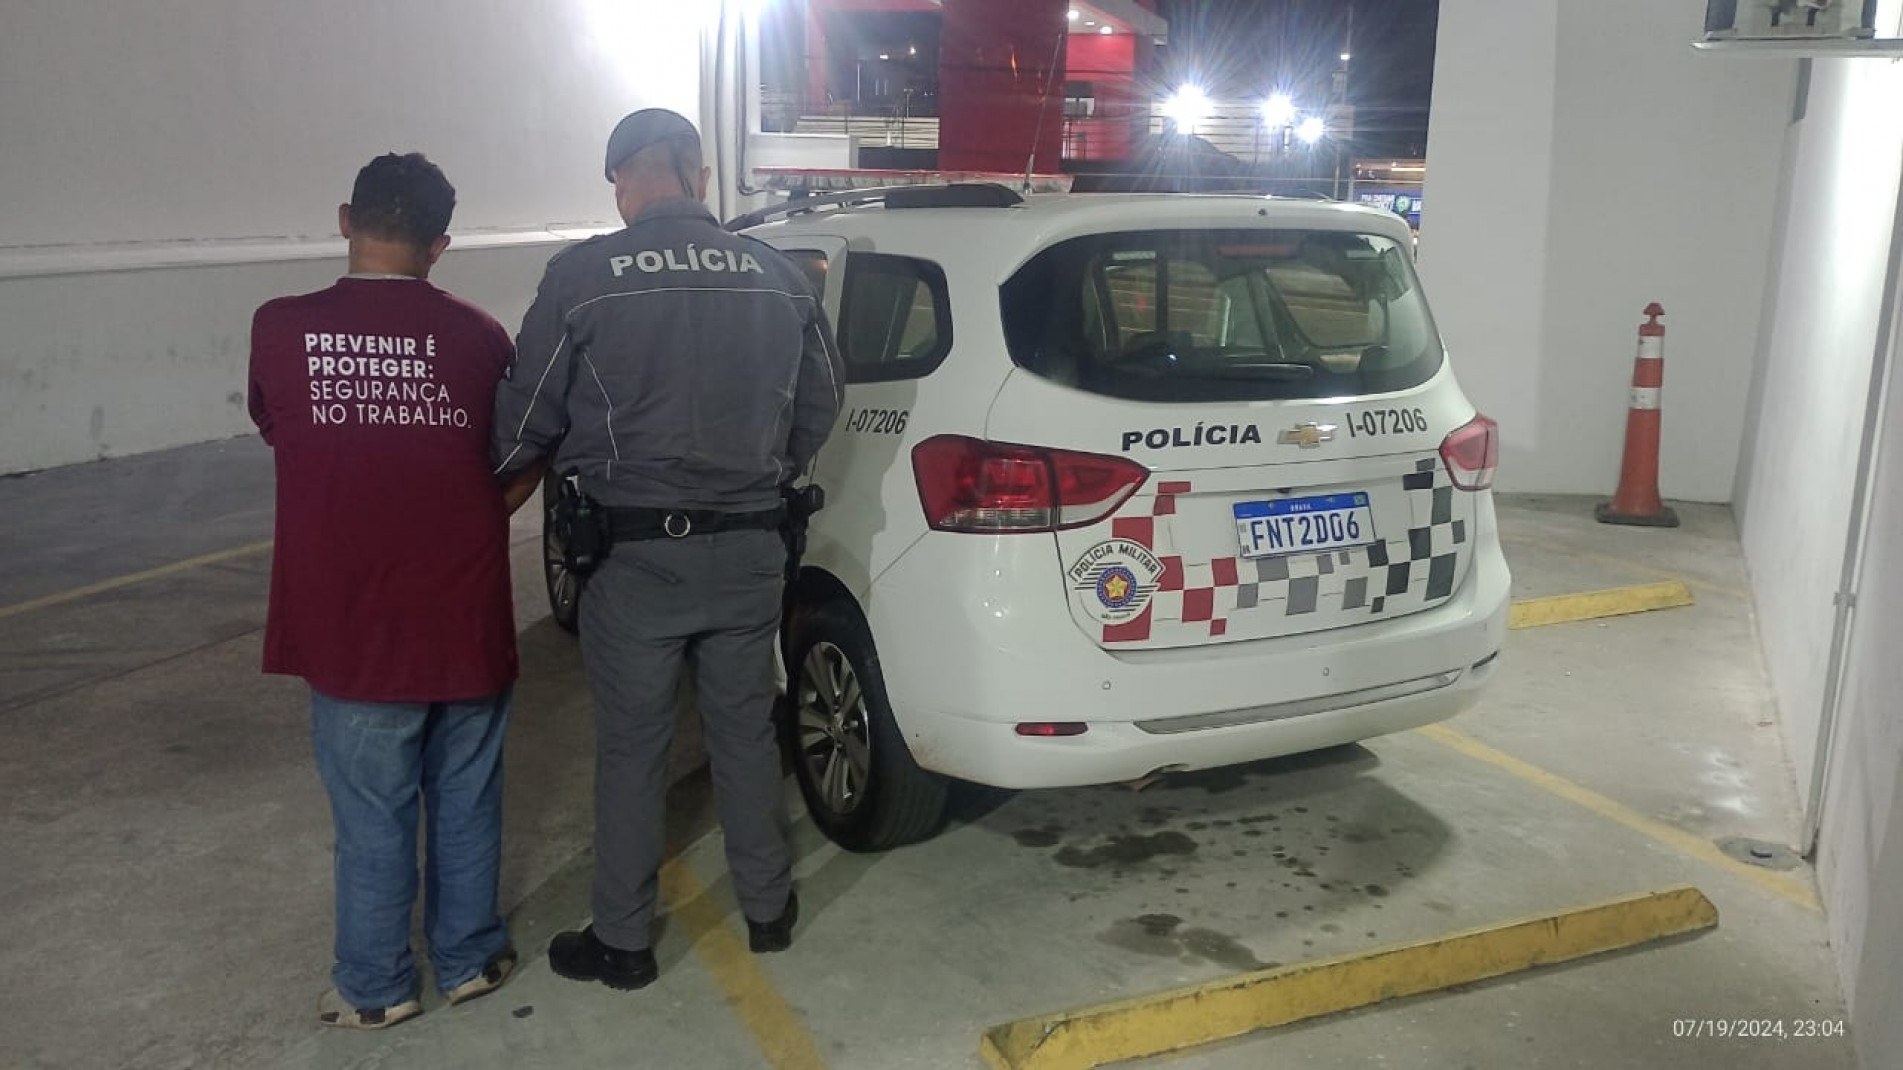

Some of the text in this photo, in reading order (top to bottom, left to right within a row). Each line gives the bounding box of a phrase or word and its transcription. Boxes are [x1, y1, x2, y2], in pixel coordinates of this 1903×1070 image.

[610, 243, 764, 277] POLÍCIA
[304, 333, 436, 357] PREVENIR É
[308, 356, 434, 379] PROTEGER:
[310, 379, 450, 407] SEGURANÇA
[312, 403, 472, 429] NO TRABALHO.
[845, 407, 909, 435] I-07206
[1346, 408, 1428, 437] I-07206
[1122, 421, 1261, 451] POLÍCIA
[1251, 511, 1360, 550] FNT2D06
[1118, 544, 1158, 575] MILITAR
